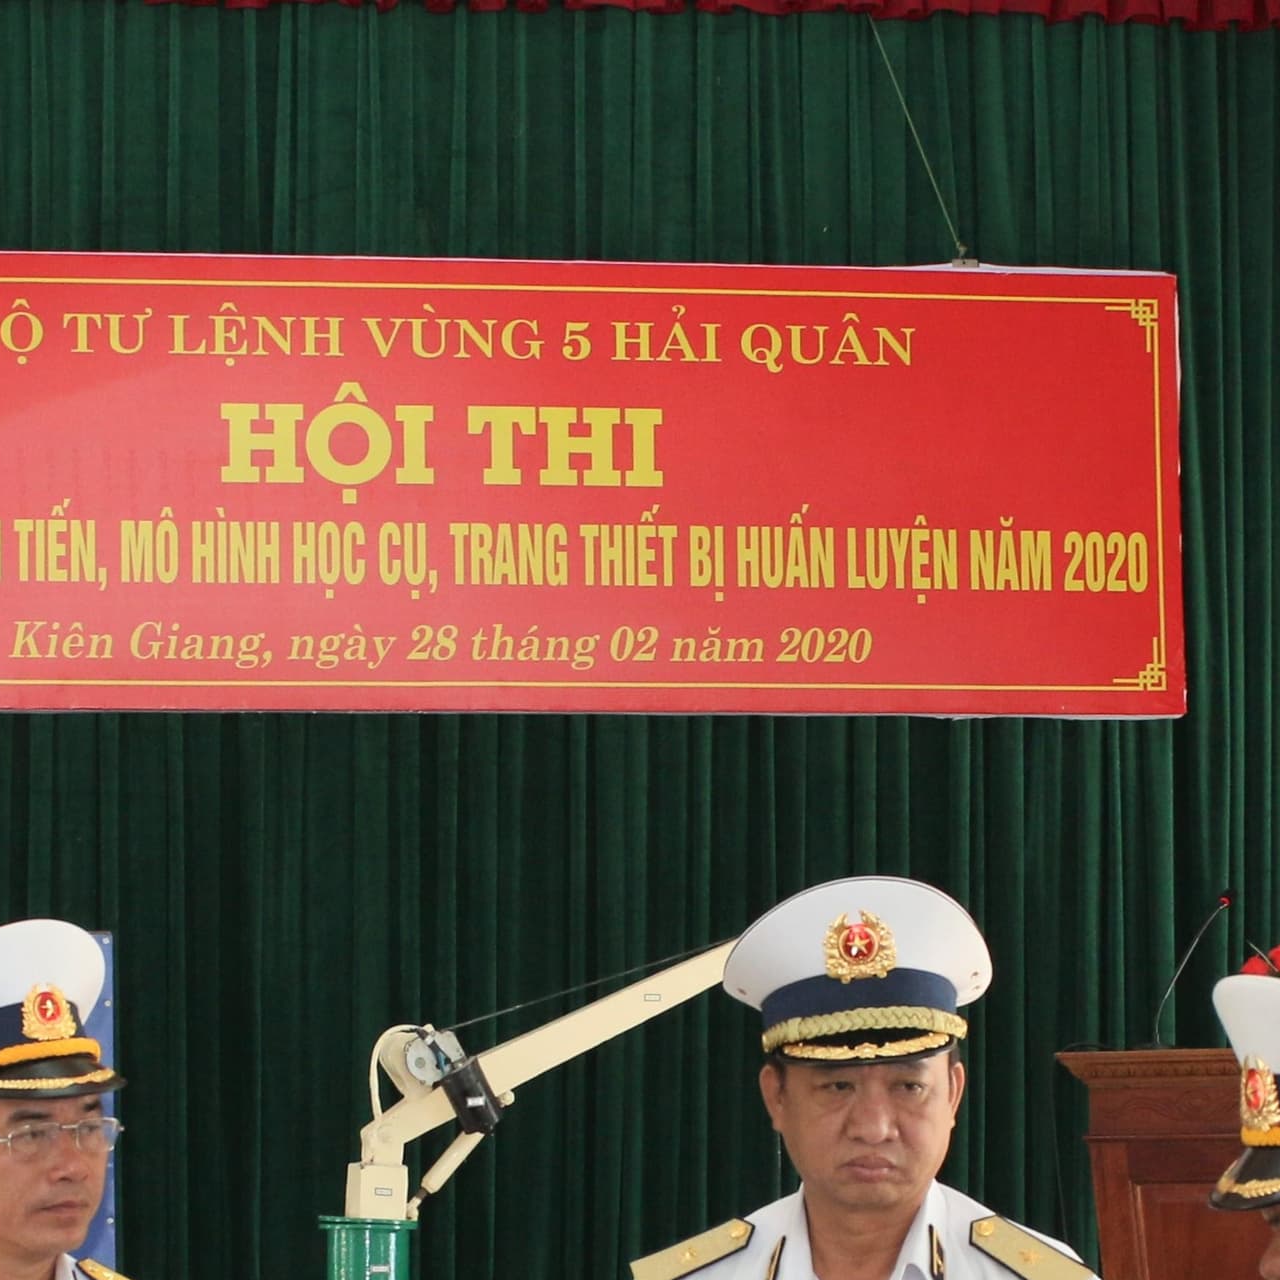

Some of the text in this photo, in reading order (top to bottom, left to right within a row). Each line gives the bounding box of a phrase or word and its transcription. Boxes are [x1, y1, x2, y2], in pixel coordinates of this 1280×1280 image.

[63, 307, 153, 355] TƯ
[169, 301, 345, 368] LỆNH
[362, 303, 545, 360] VÙNG
[562, 322, 591, 361] 5
[611, 305, 721, 362] HẢI
[740, 312, 915, 373] QUÂN
[219, 381, 664, 505] HỘI THI
[12, 497, 109, 591] TIẾN,
[118, 505, 181, 586] MÔ
[190, 506, 282, 585] HÌNH
[291, 520, 369, 600] HỌC
[377, 520, 439, 601] CỤ,
[448, 522, 569, 587] TRANG
[579, 504, 678, 587] THIẾT
[689, 525, 725, 602] BỊ
[736, 503, 835, 589] HUẤN
[847, 514, 958, 604] LUYỆN
[969, 516, 1052, 591] NĂM
[1063, 531, 1148, 593] 2020
[10, 620, 873, 671] Kiên Giang, ngày 28 tháng 02 năm 2020
